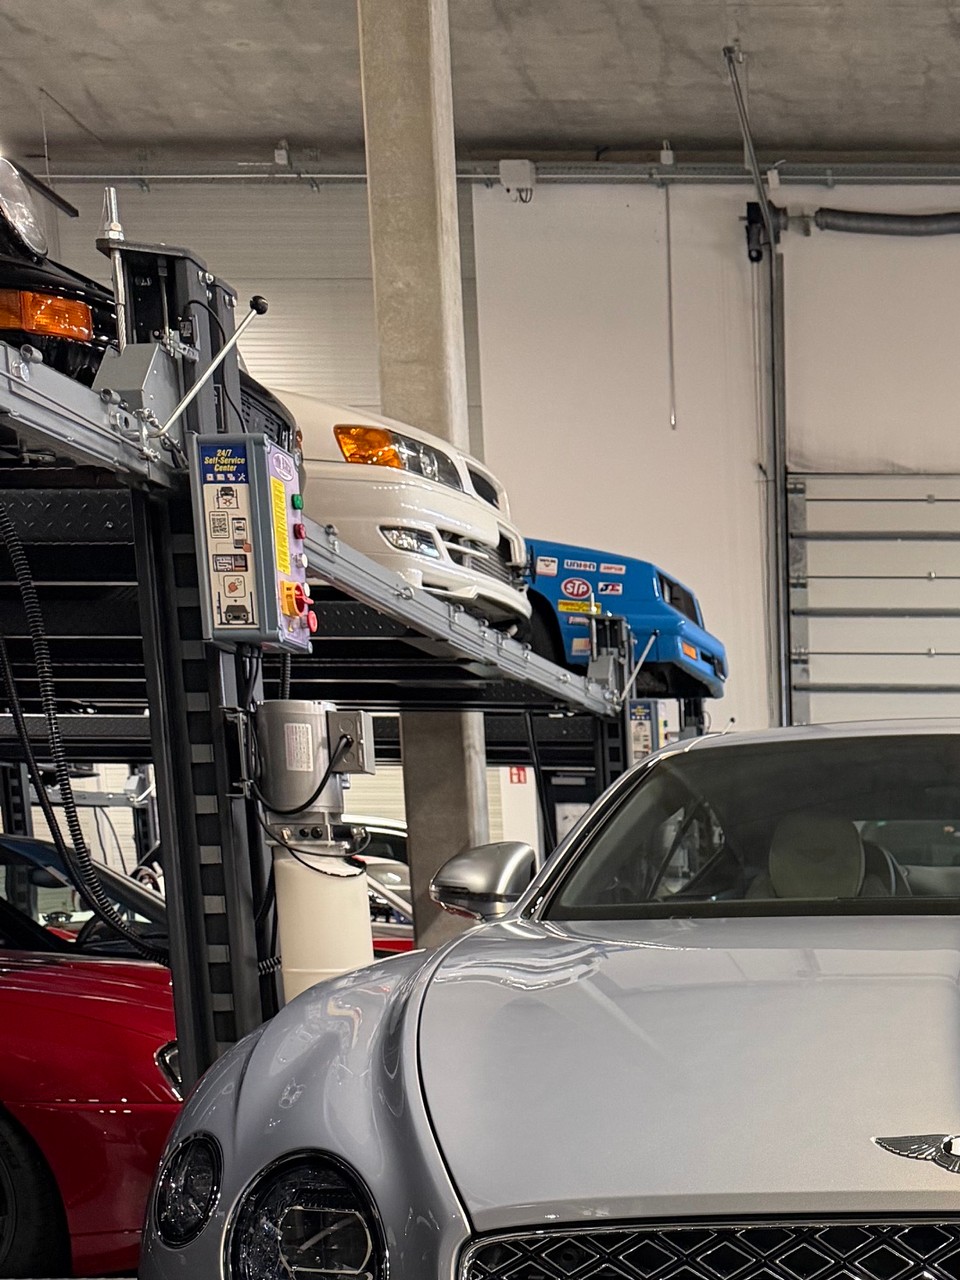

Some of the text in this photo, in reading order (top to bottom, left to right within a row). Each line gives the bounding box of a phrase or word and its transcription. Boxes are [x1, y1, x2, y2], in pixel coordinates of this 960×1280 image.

[216, 449, 233, 457] 24/7
[204, 456, 246, 465] Self-Service
[214, 464, 237, 472] Center
[565, 580, 588, 596] STP
